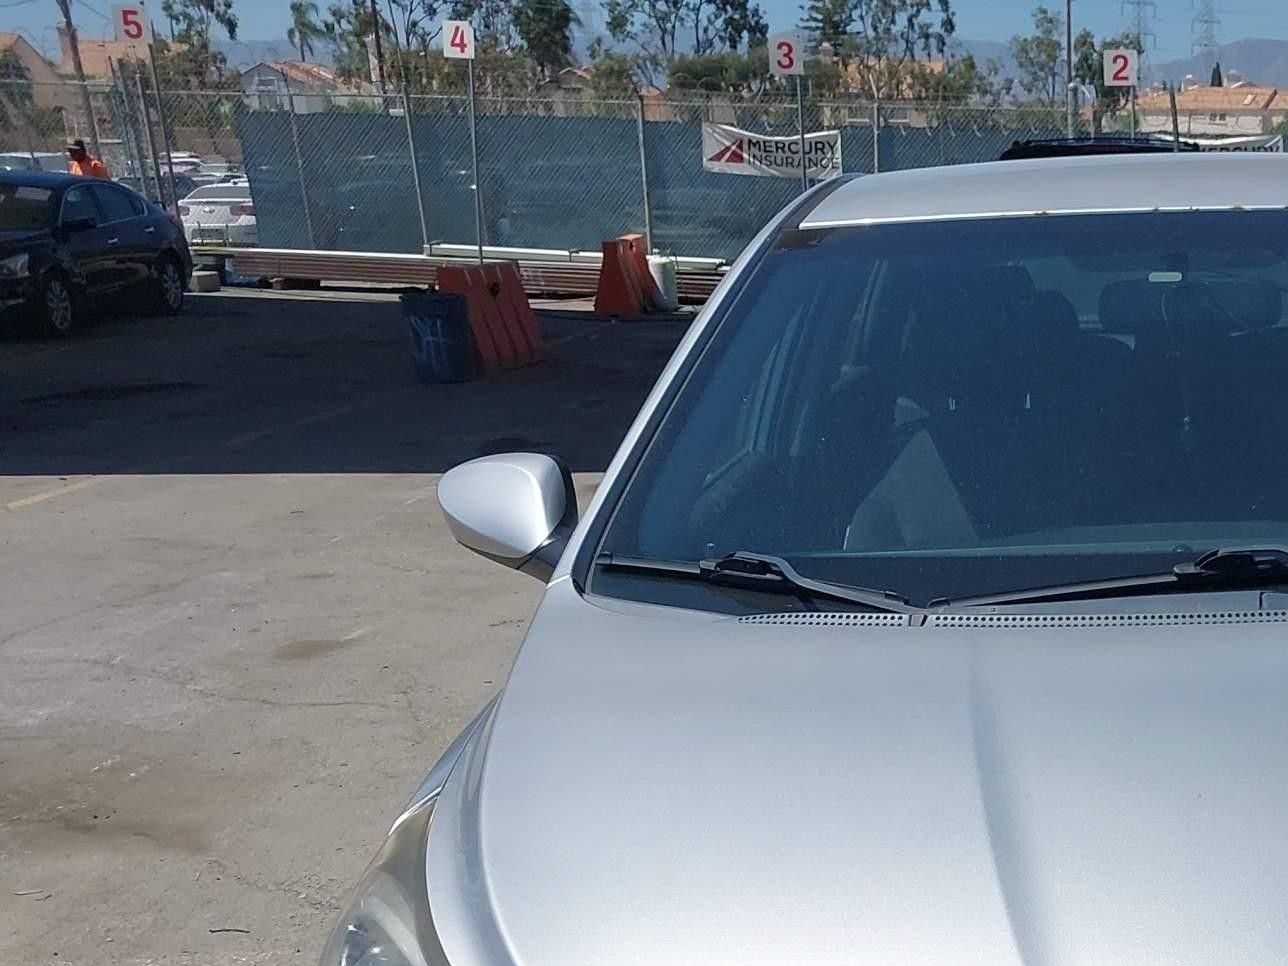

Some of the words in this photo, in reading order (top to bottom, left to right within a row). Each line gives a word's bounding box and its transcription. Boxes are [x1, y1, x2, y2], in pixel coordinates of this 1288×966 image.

[122, 9, 143, 39] 5
[450, 25, 468, 54] 4
[776, 41, 794, 70] 3
[1112, 54, 1129, 81] 2
[747, 137, 838, 156] MERCURY
